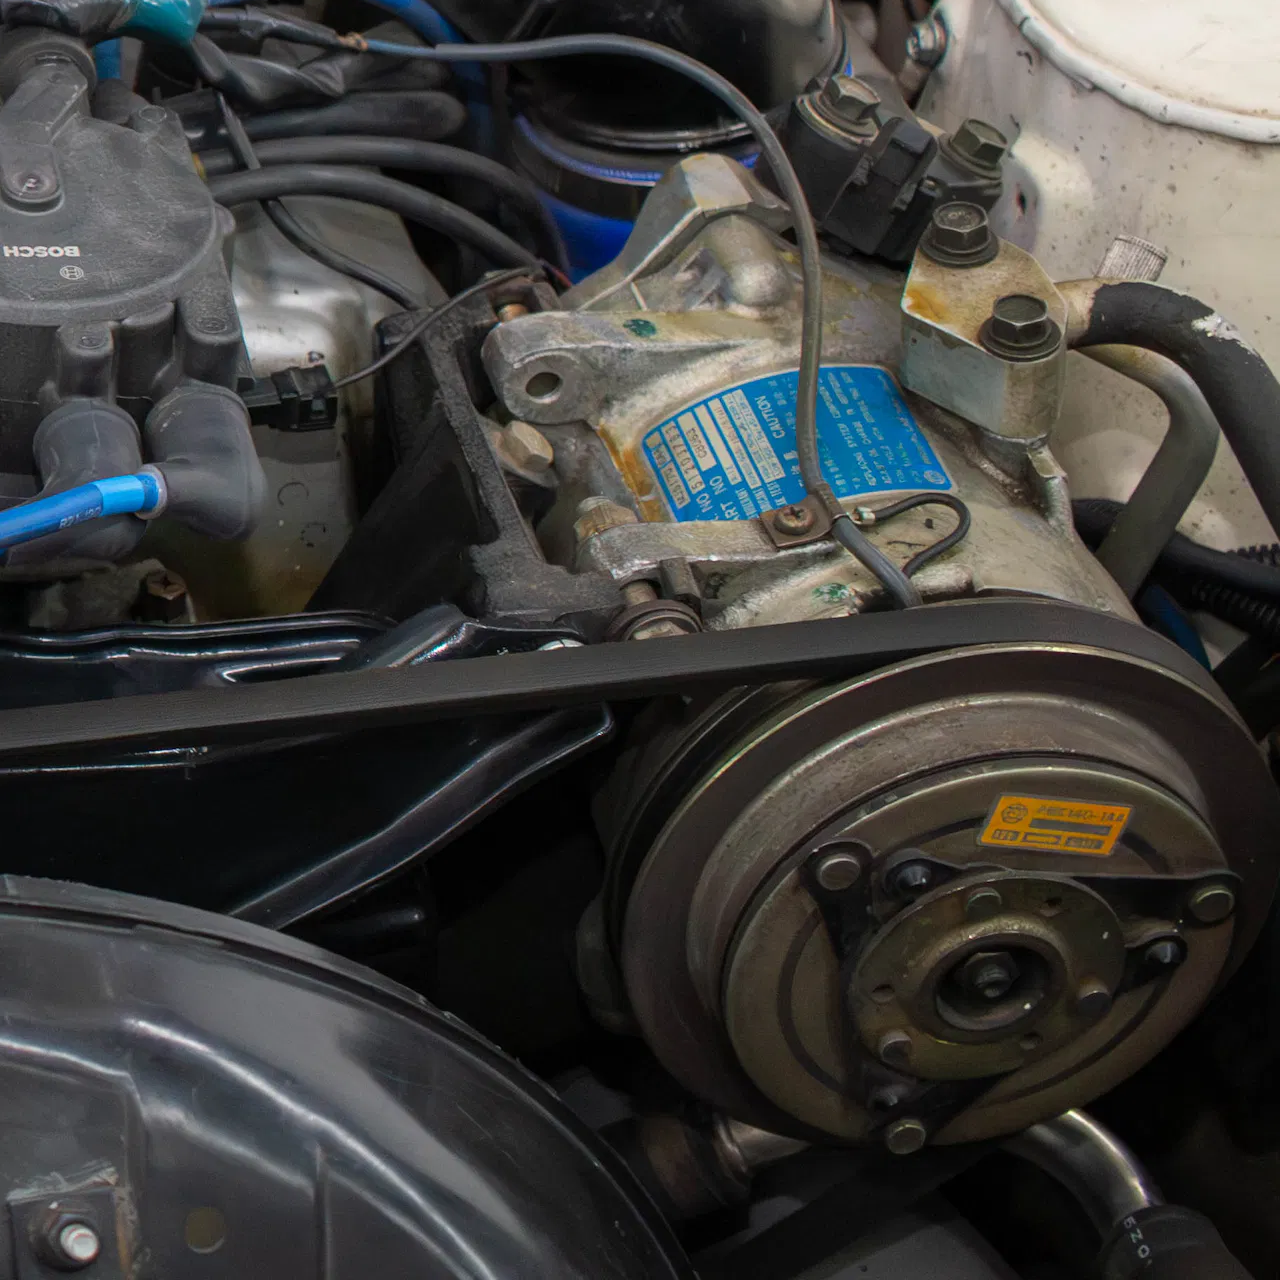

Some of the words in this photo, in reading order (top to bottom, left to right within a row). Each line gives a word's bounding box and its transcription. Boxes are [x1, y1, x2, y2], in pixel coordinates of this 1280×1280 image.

[2, 245, 81, 258] BOSCH
[755, 394, 786, 439] CAUTION
[709, 475, 728, 495] NO
